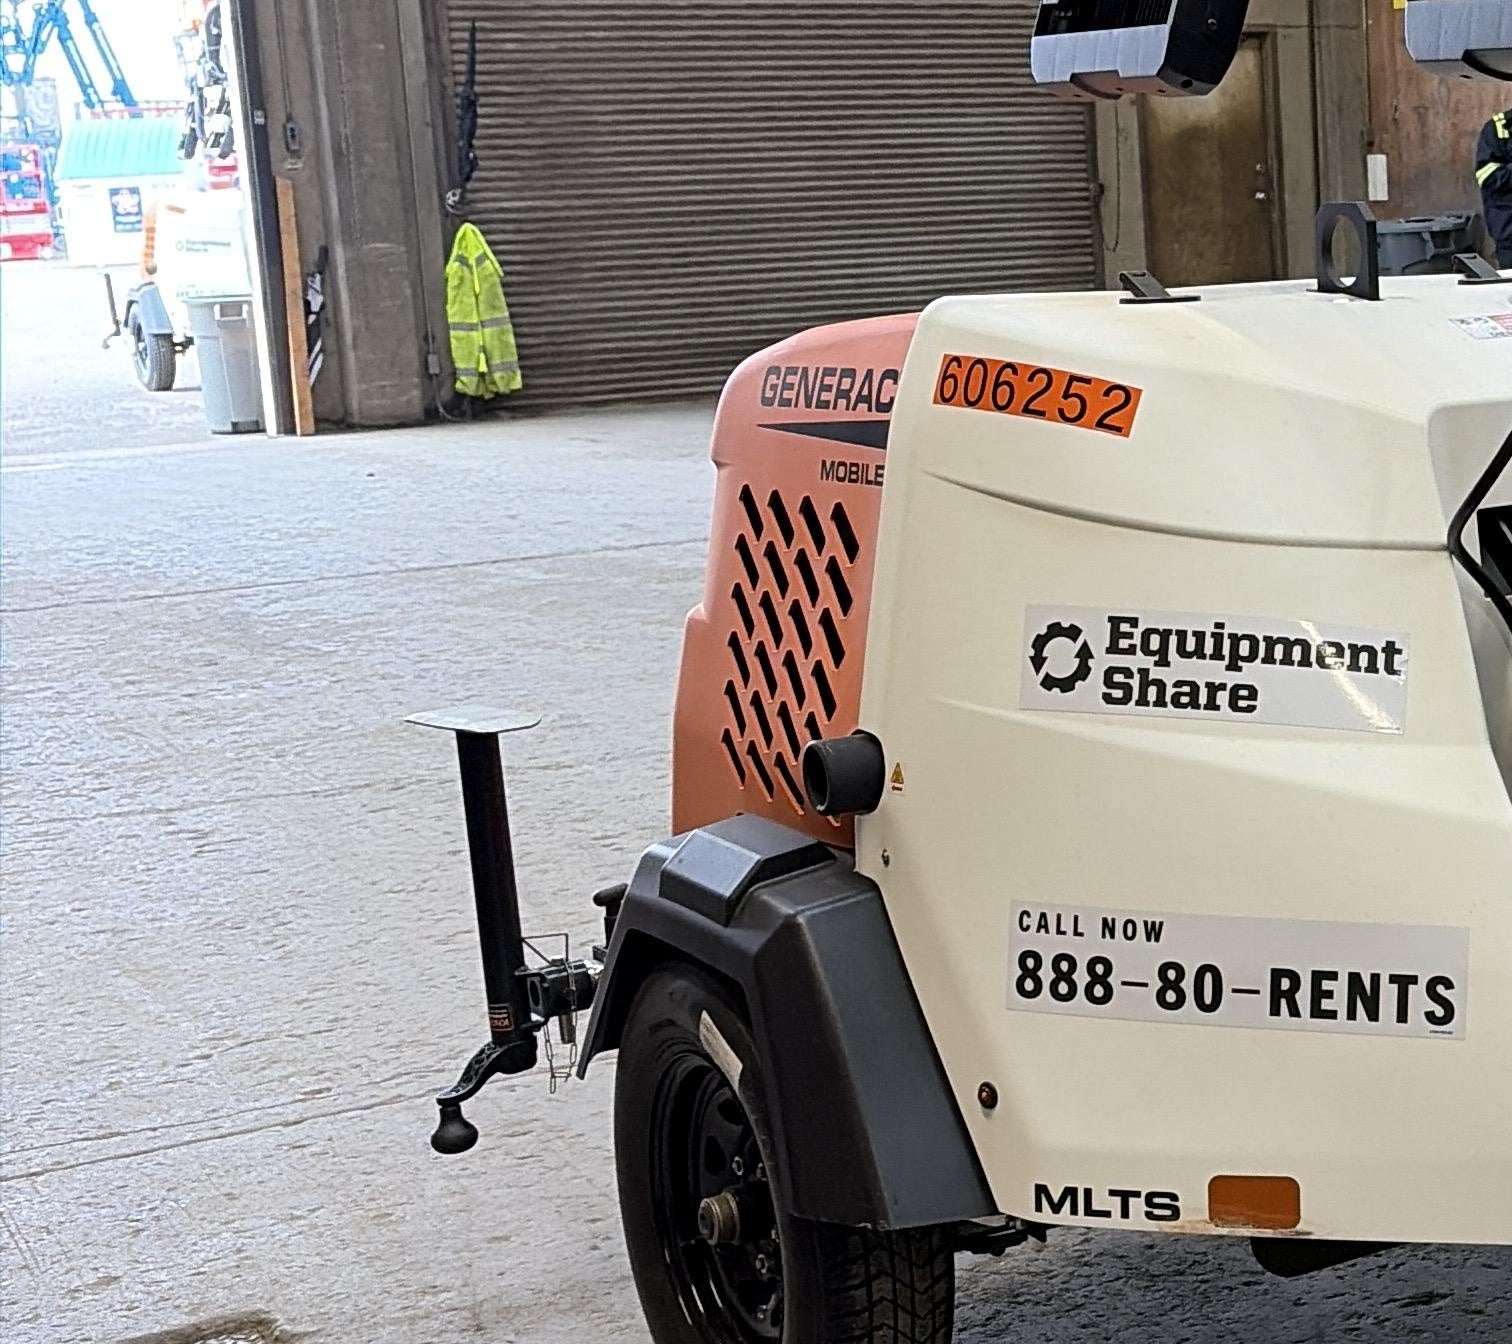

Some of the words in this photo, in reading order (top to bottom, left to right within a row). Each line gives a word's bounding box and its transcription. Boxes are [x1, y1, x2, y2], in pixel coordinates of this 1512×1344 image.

[761, 365, 900, 413] GENERAC
[939, 356, 1132, 433] 606252
[820, 459, 885, 487] MOBILE
[1105, 615, 1404, 676] Equipment
[1101, 665, 1259, 714] Share
[1018, 910, 1085, 938] CALL
[1101, 916, 1165, 944] NOW
[1015, 949, 1456, 1027] 888-80-RENTS
[1034, 1183, 1181, 1222] MLTS
